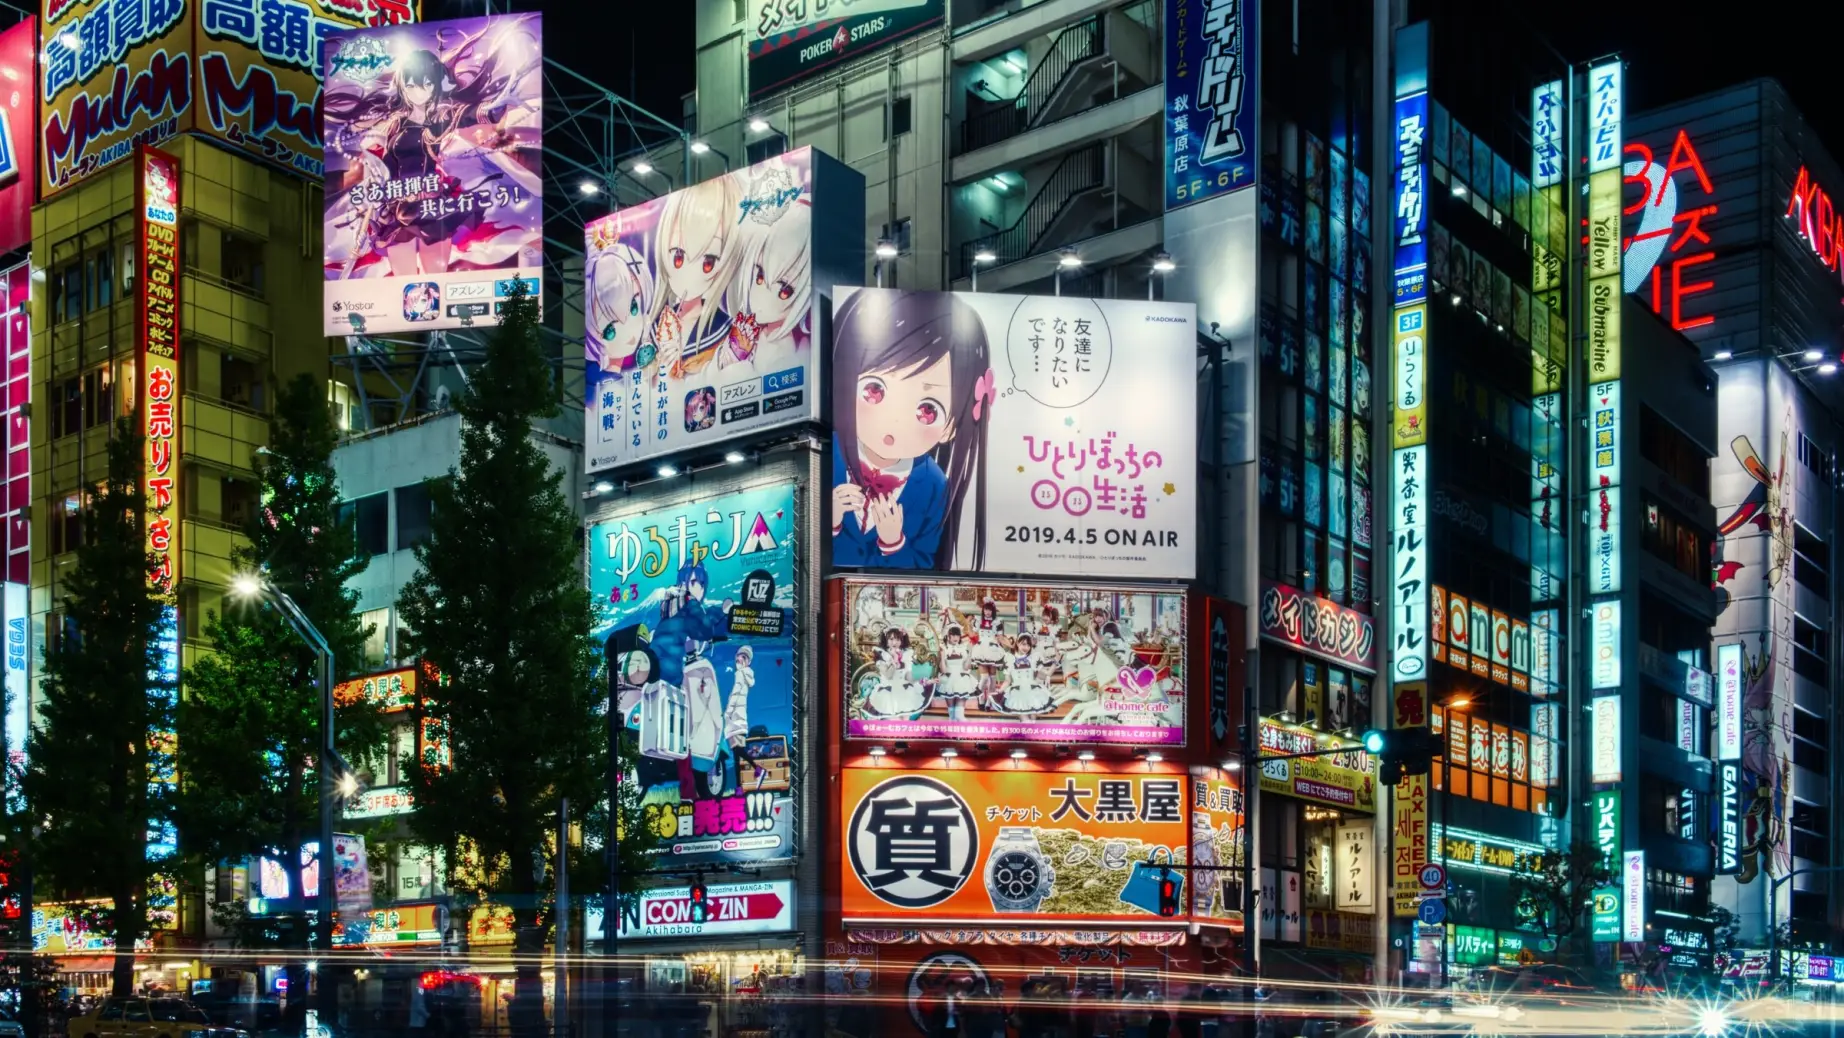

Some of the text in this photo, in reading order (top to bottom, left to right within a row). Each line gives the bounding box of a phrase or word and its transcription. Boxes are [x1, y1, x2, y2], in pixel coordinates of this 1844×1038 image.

[205, 0, 325, 78] 高額
[800, 39, 832, 63] POKER
[850, 17, 884, 42] STARS
[45, 49, 191, 187] Mulan
[1596, 73, 1616, 162] スーパービル
[226, 123, 294, 163] ムーラン
[1174, 94, 1189, 174] 秋葉原店
[58, 153, 99, 187] ムーラン
[99, 138, 132, 168] AKIBA
[350, 173, 450, 205] さあ指揮官、
[147, 206, 174, 222] あなたの
[148, 224, 174, 242] DVD
[147, 253, 174, 273] ゲーム
[151, 269, 170, 285] CD
[147, 282, 174, 300] アイドル
[449, 286, 486, 296] アズレン
[1594, 216, 1610, 373] Yellow Submarine
[147, 296, 174, 315] アニメ
[343, 301, 375, 311] Yostar
[148, 312, 174, 329] コミック
[1151, 316, 1188, 324] KADOKAWA
[1402, 314, 1420, 329] 3F
[149, 326, 173, 342] ホビー
[148, 341, 174, 357] フィギュア
[1052, 317, 1069, 388] なりたい
[1074, 318, 1092, 373] 友達に
[781, 372, 798, 385] 検索
[1404, 340, 1416, 406] りらくる
[724, 384, 756, 401] アズレン
[1597, 384, 1613, 396] 5F
[632, 371, 643, 447] 望んでいる
[656, 365, 669, 441] これが君の
[1023, 431, 1163, 480] ひとりぼっちの
[1005, 525, 1179, 548] 2019.4.5 ON AIR
[747, 579, 771, 600] FUZ
[1263, 588, 1373, 662] メイドカジノ
[9, 616, 25, 671] SEGA
[1049, 778, 1184, 822] 大黒屋
[987, 807, 1042, 821] チケット
[1723, 763, 1737, 870] GALLERIA
[865, 797, 963, 892] 質
[1349, 843, 1362, 902] ルノアール
[1423, 870, 1440, 883] 40
[739, 883, 774, 893] MANGA-ZIN
[647, 898, 748, 924] COMC ZIN
[1424, 905, 1435, 921] P
[646, 924, 703, 936] Akihabara
[1058, 946, 1131, 963] チケット
[1456, 935, 1495, 955] リバティー
